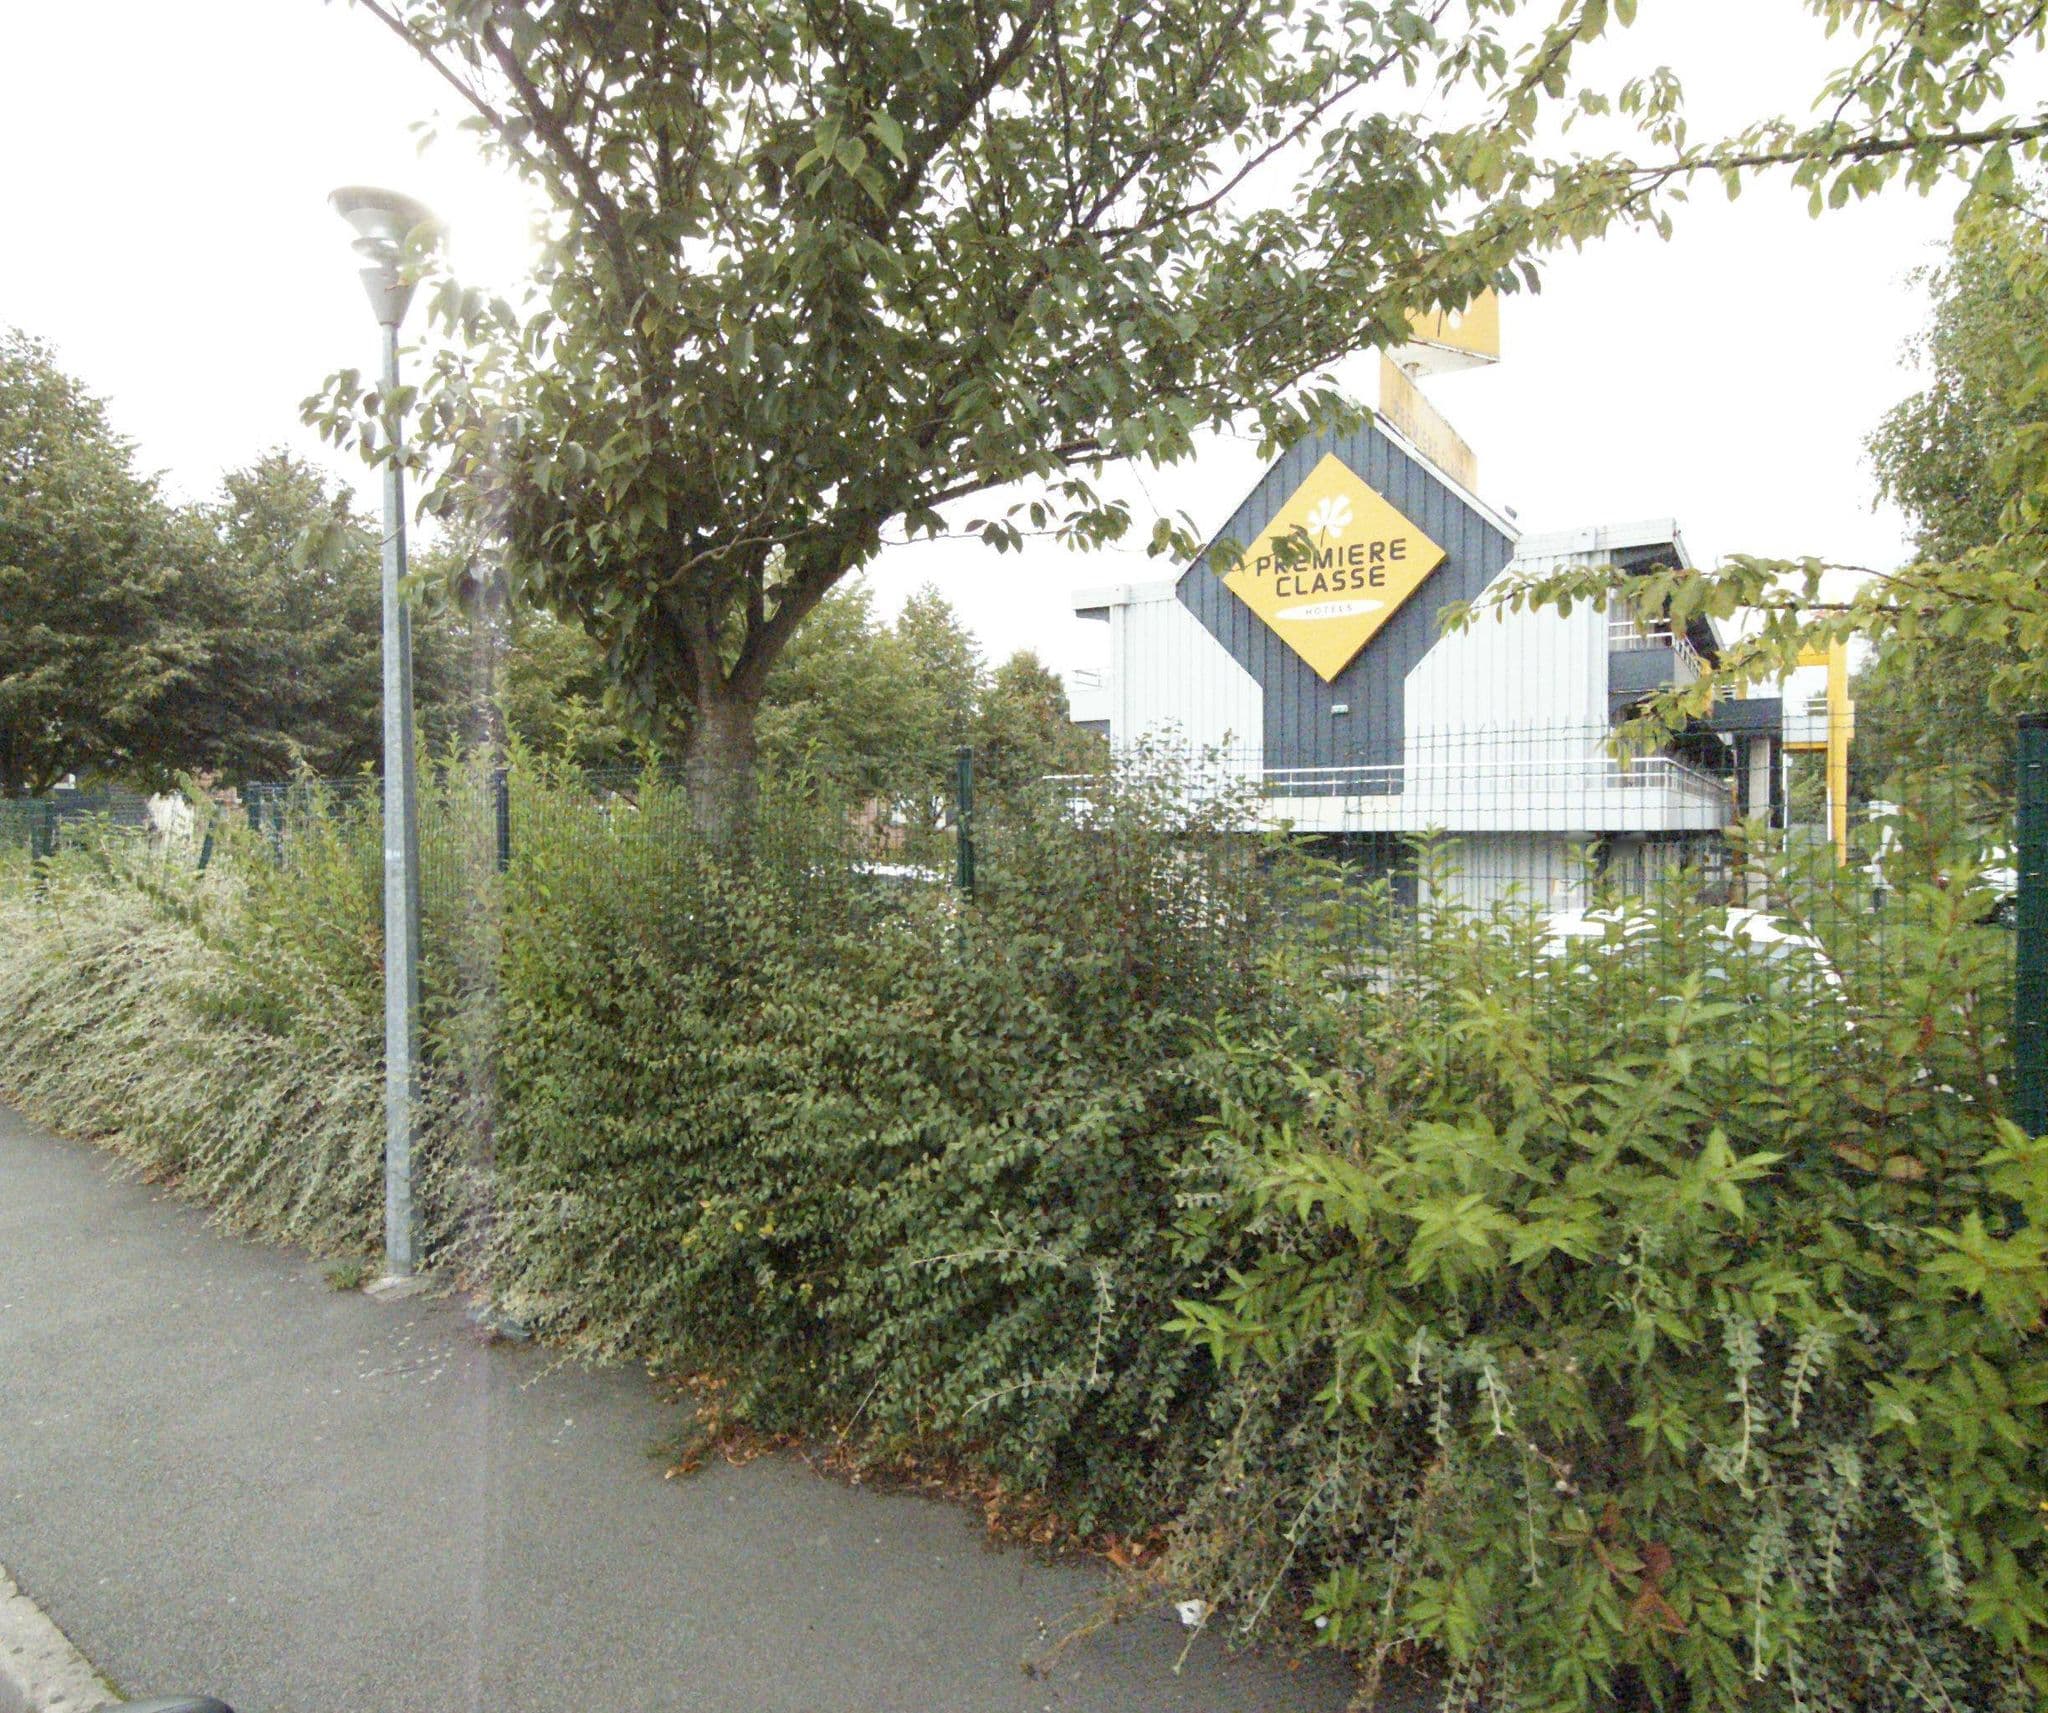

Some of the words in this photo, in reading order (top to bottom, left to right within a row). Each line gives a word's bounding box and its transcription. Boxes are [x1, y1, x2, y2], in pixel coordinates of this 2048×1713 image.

[1256, 538, 1406, 576] PREMIERE
[1276, 565, 1385, 597] CLASSE
[1305, 604, 1353, 616] HOTELS
